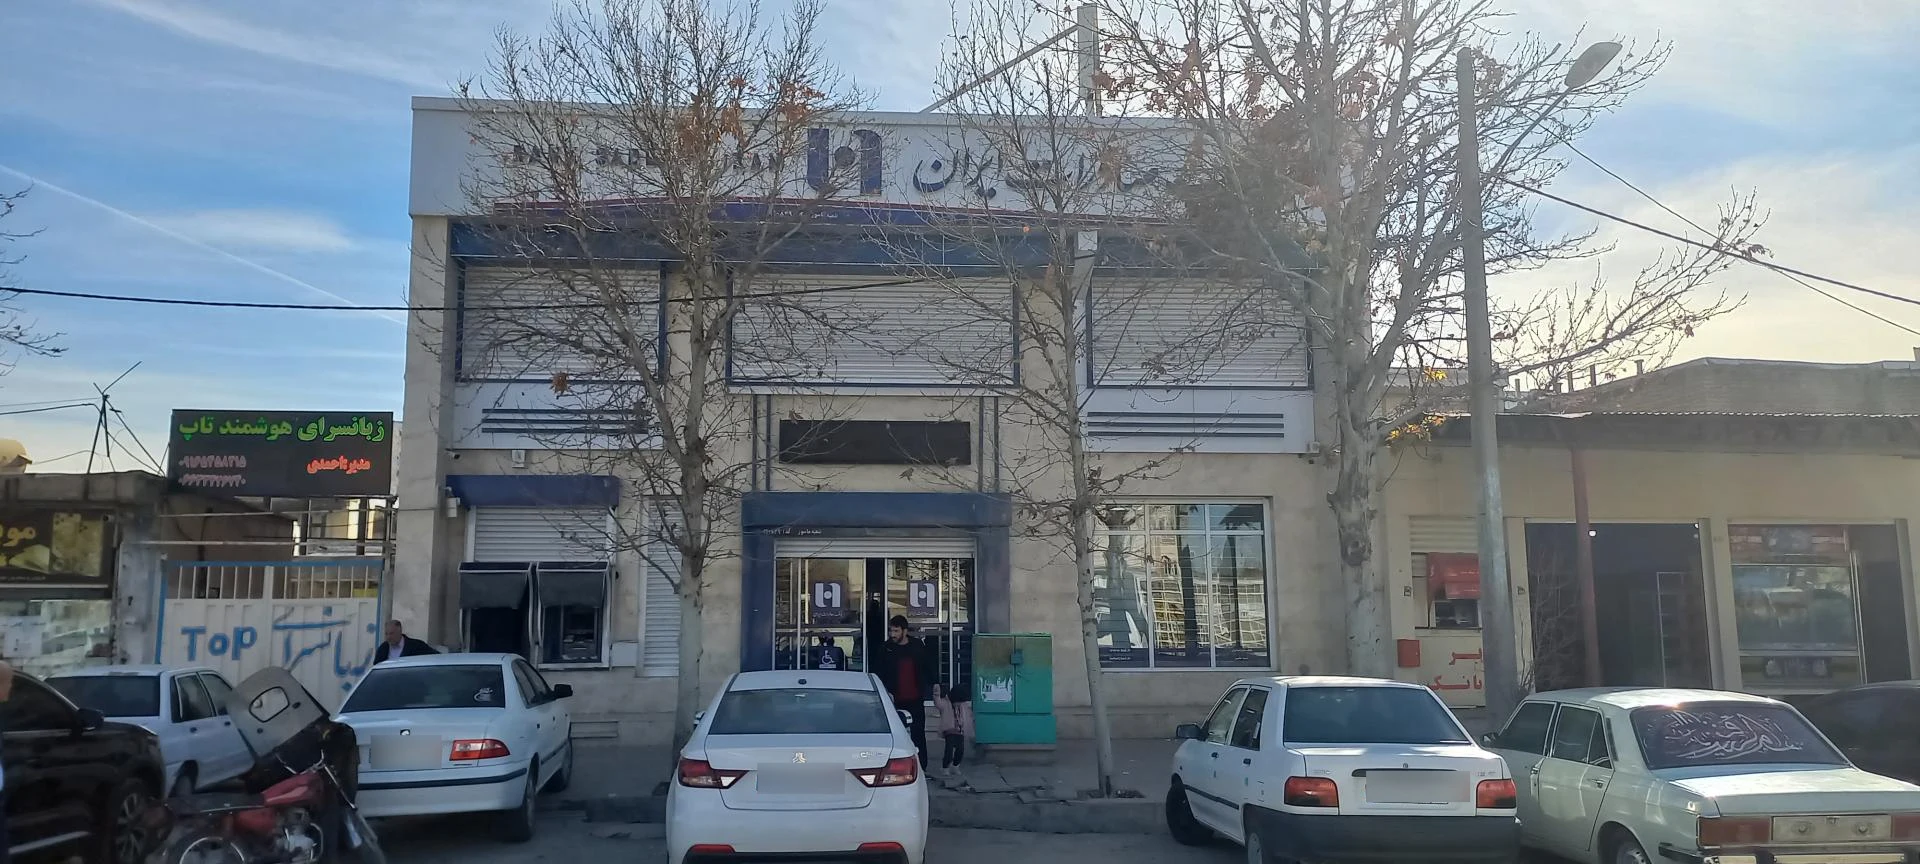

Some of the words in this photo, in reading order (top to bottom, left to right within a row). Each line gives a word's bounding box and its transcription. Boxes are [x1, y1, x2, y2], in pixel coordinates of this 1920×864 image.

[178, 415, 214, 441] تاپ
[219, 417, 292, 441] هوشمند
[298, 416, 385, 442] زبانسرای
